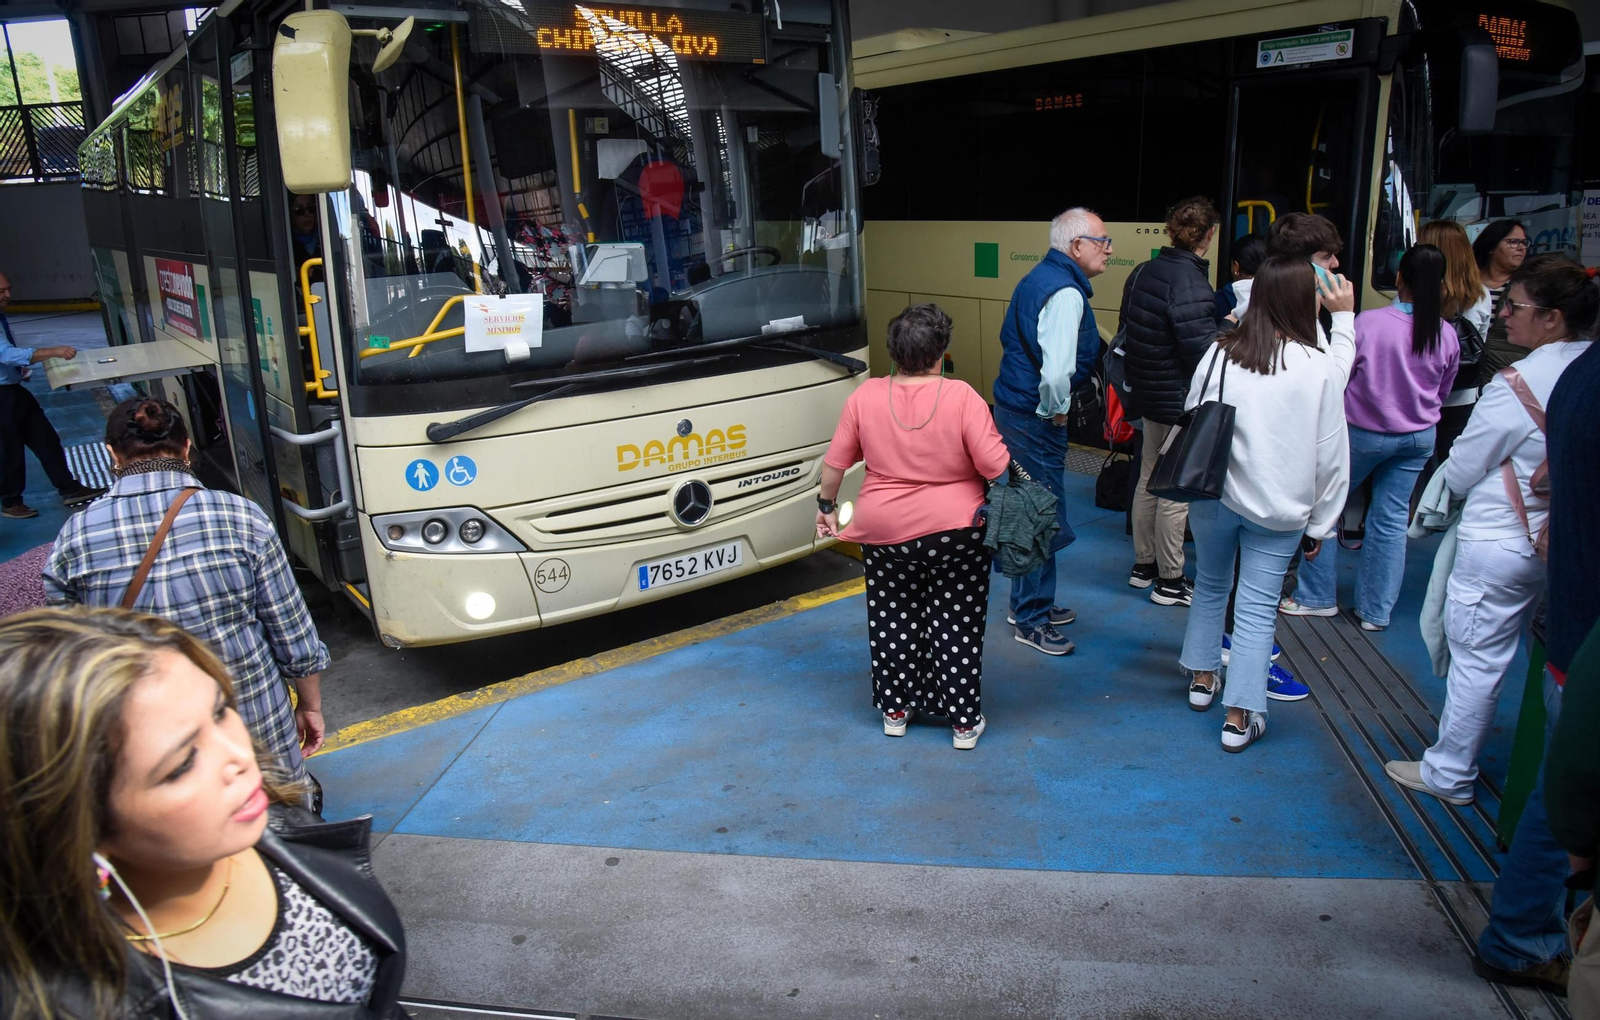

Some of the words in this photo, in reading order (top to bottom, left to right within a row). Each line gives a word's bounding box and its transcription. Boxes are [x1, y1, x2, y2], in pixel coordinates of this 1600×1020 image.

[1035, 93, 1084, 111] DAMAS
[1010, 251, 1039, 262] Consorcio
[483, 314, 525, 323] SERVICIOS
[616, 424, 747, 472] DAMAS
[668, 459, 700, 472] GRUPO
[703, 449, 747, 464] INTERBUS
[737, 467, 801, 489] INTOURO
[536, 565, 568, 585] 544
[650, 556, 698, 585] 7652
[704, 545, 737, 571] KVJ
